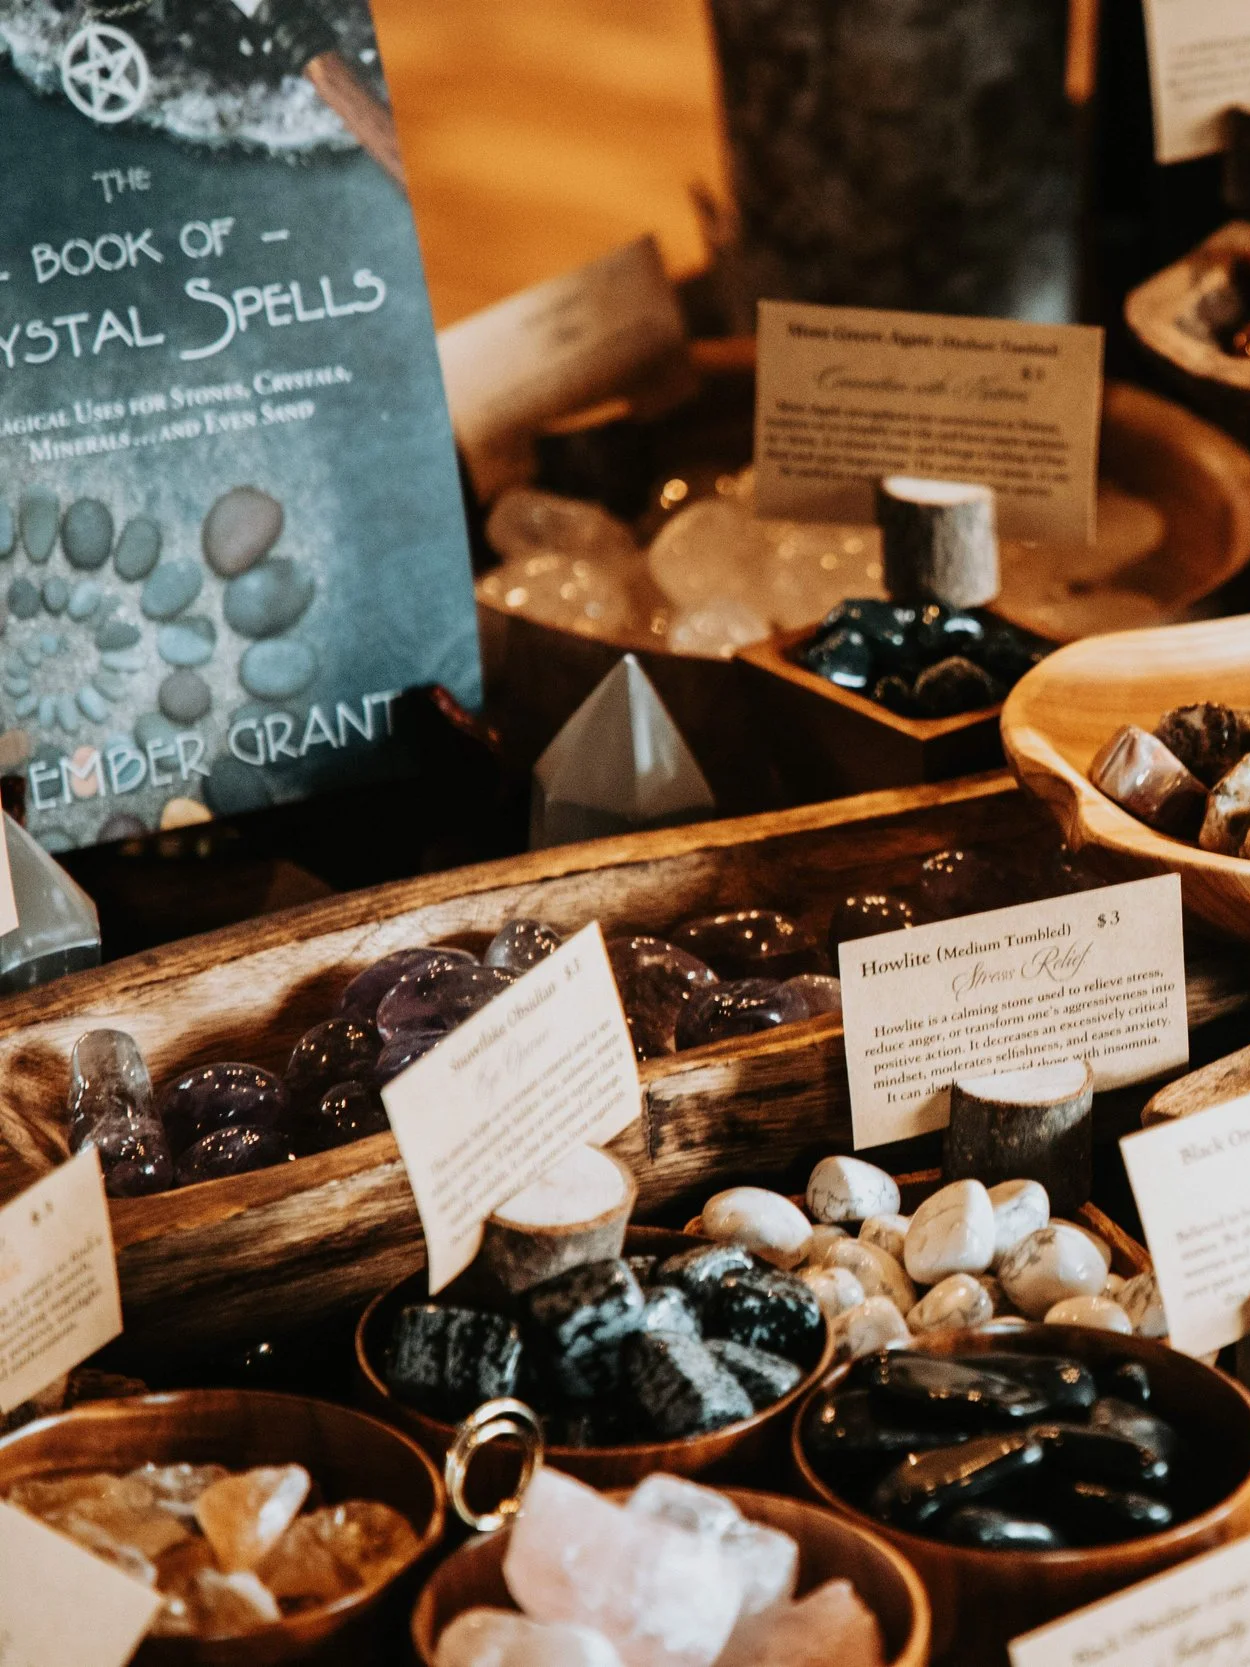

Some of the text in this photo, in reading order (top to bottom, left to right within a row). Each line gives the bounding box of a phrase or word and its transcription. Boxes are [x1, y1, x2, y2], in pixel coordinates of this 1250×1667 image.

[92, 166, 151, 203] THE
[31, 216, 236, 284] BOOK OF
[28, 690, 398, 810] EMBER GRANT
[860, 951, 931, 978] Howlite
[935, 940, 1001, 962] (Medium
[1003, 922, 1071, 947] Tumbled)
[950, 941, 1093, 1001] Stress Relief
[863, 1041, 904, 1057] reduce
[907, 1033, 946, 1048] anger,
[947, 1028, 961, 1039] or
[964, 1014, 1024, 1035] transform
[1062, 989, 1148, 1014] aggressiveness
[1150, 982, 1176, 995] into
[872, 995, 1168, 1075] positive action. It decreases an excessively critical
[873, 969, 1164, 1038] Howlite is a calming stone used to relieve stress,
[872, 1070, 927, 1090] mindset,
[929, 1056, 992, 1077] moderates
[994, 1041, 1063, 1062] selfishness,
[1065, 1029, 1088, 1047] and
[1090, 1027, 1122, 1041] eases
[886, 1091, 897, 1104] It
[899, 1088, 921, 1101] can
[924, 1081, 950, 1097] also
[1071, 1045, 1100, 1062] with
[1102, 1035, 1161, 1056] insomnia.
[1177, 1136, 1225, 1166] Black
